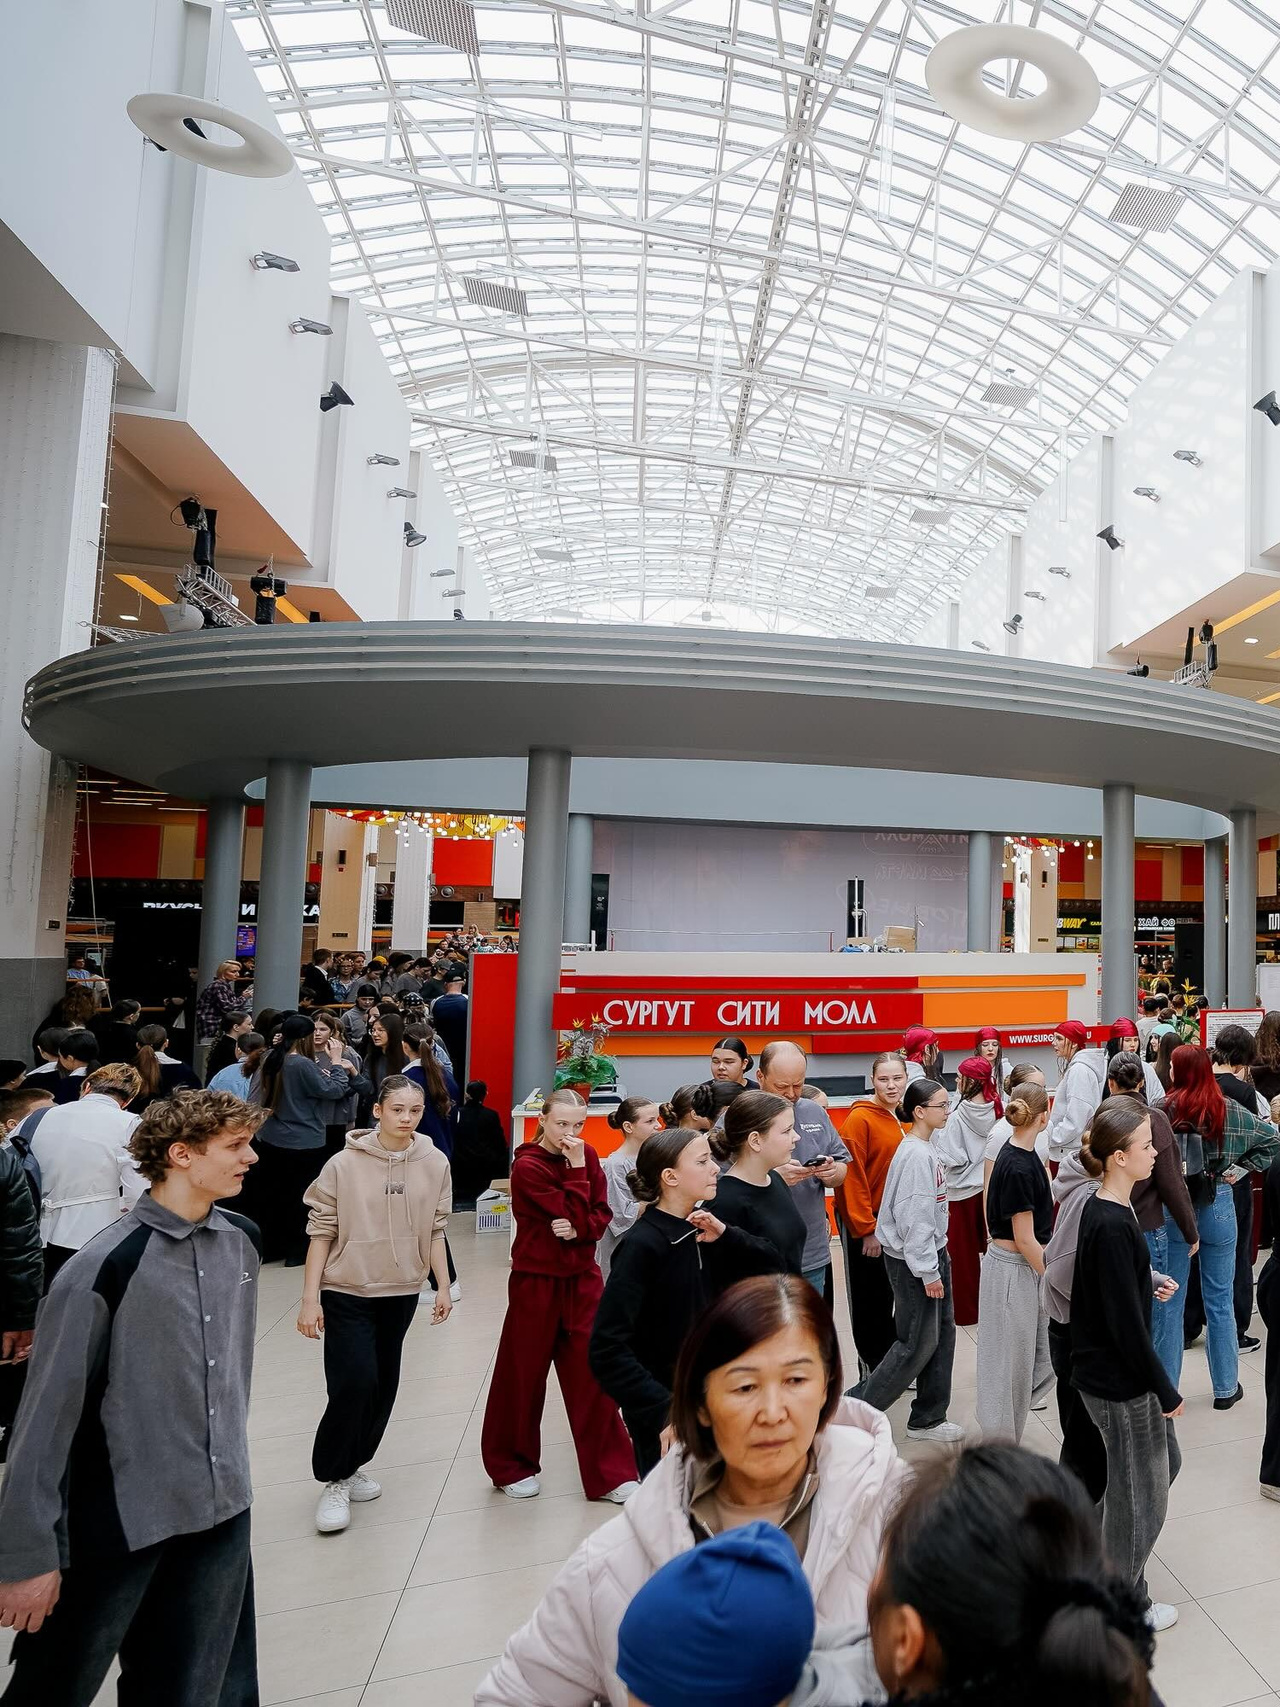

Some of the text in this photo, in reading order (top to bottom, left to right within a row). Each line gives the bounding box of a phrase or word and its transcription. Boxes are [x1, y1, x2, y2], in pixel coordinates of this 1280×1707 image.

[1056, 917, 1084, 928] BWAY
[1137, 916, 1159, 927] ХАЙ
[602, 1000, 877, 1026] СУРГУТ СИТИ МОЛЛ
